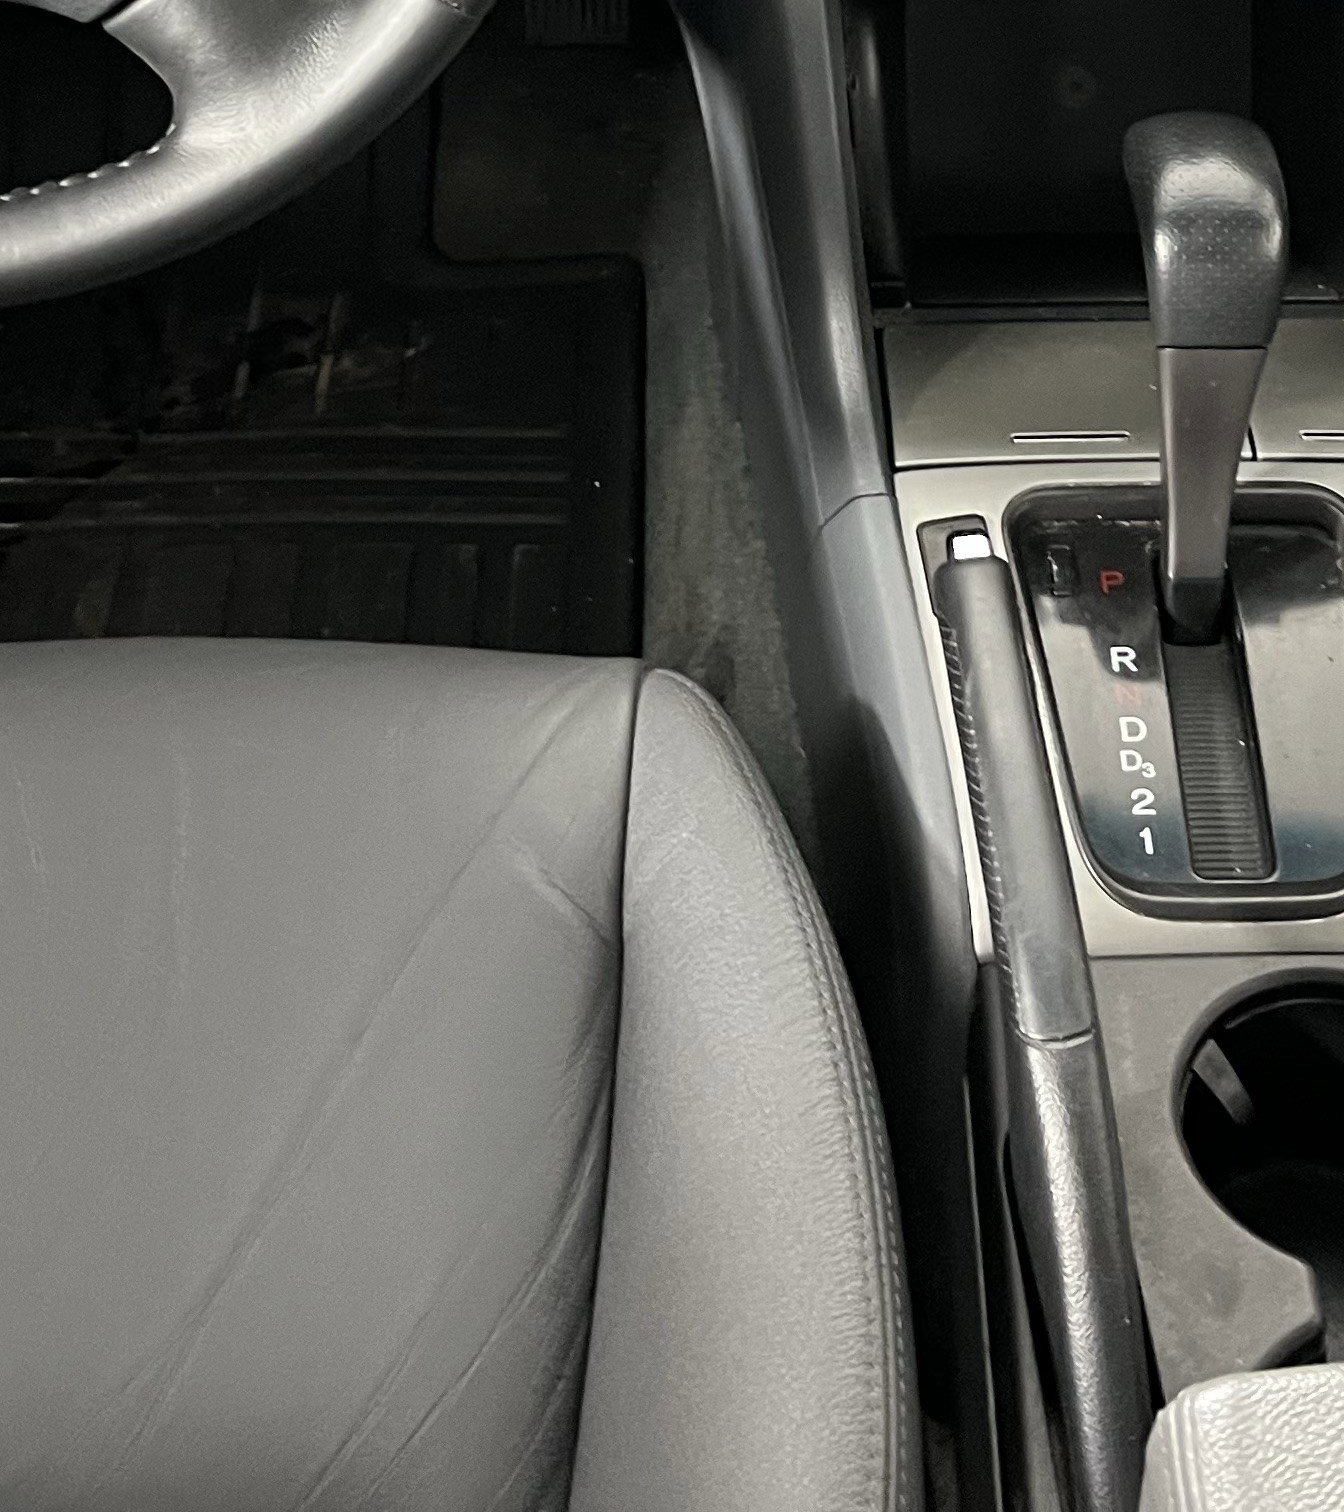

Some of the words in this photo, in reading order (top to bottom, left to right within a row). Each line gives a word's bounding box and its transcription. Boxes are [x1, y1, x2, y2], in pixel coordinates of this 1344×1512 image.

[1100, 571, 1124, 595] P
[1110, 646, 1138, 672] R
[1116, 683, 1142, 706] N
[1119, 716, 1147, 744] D
[1120, 749, 1156, 778] D3
[1131, 788, 1156, 816] 2
[1139, 826, 1154, 855] 1
